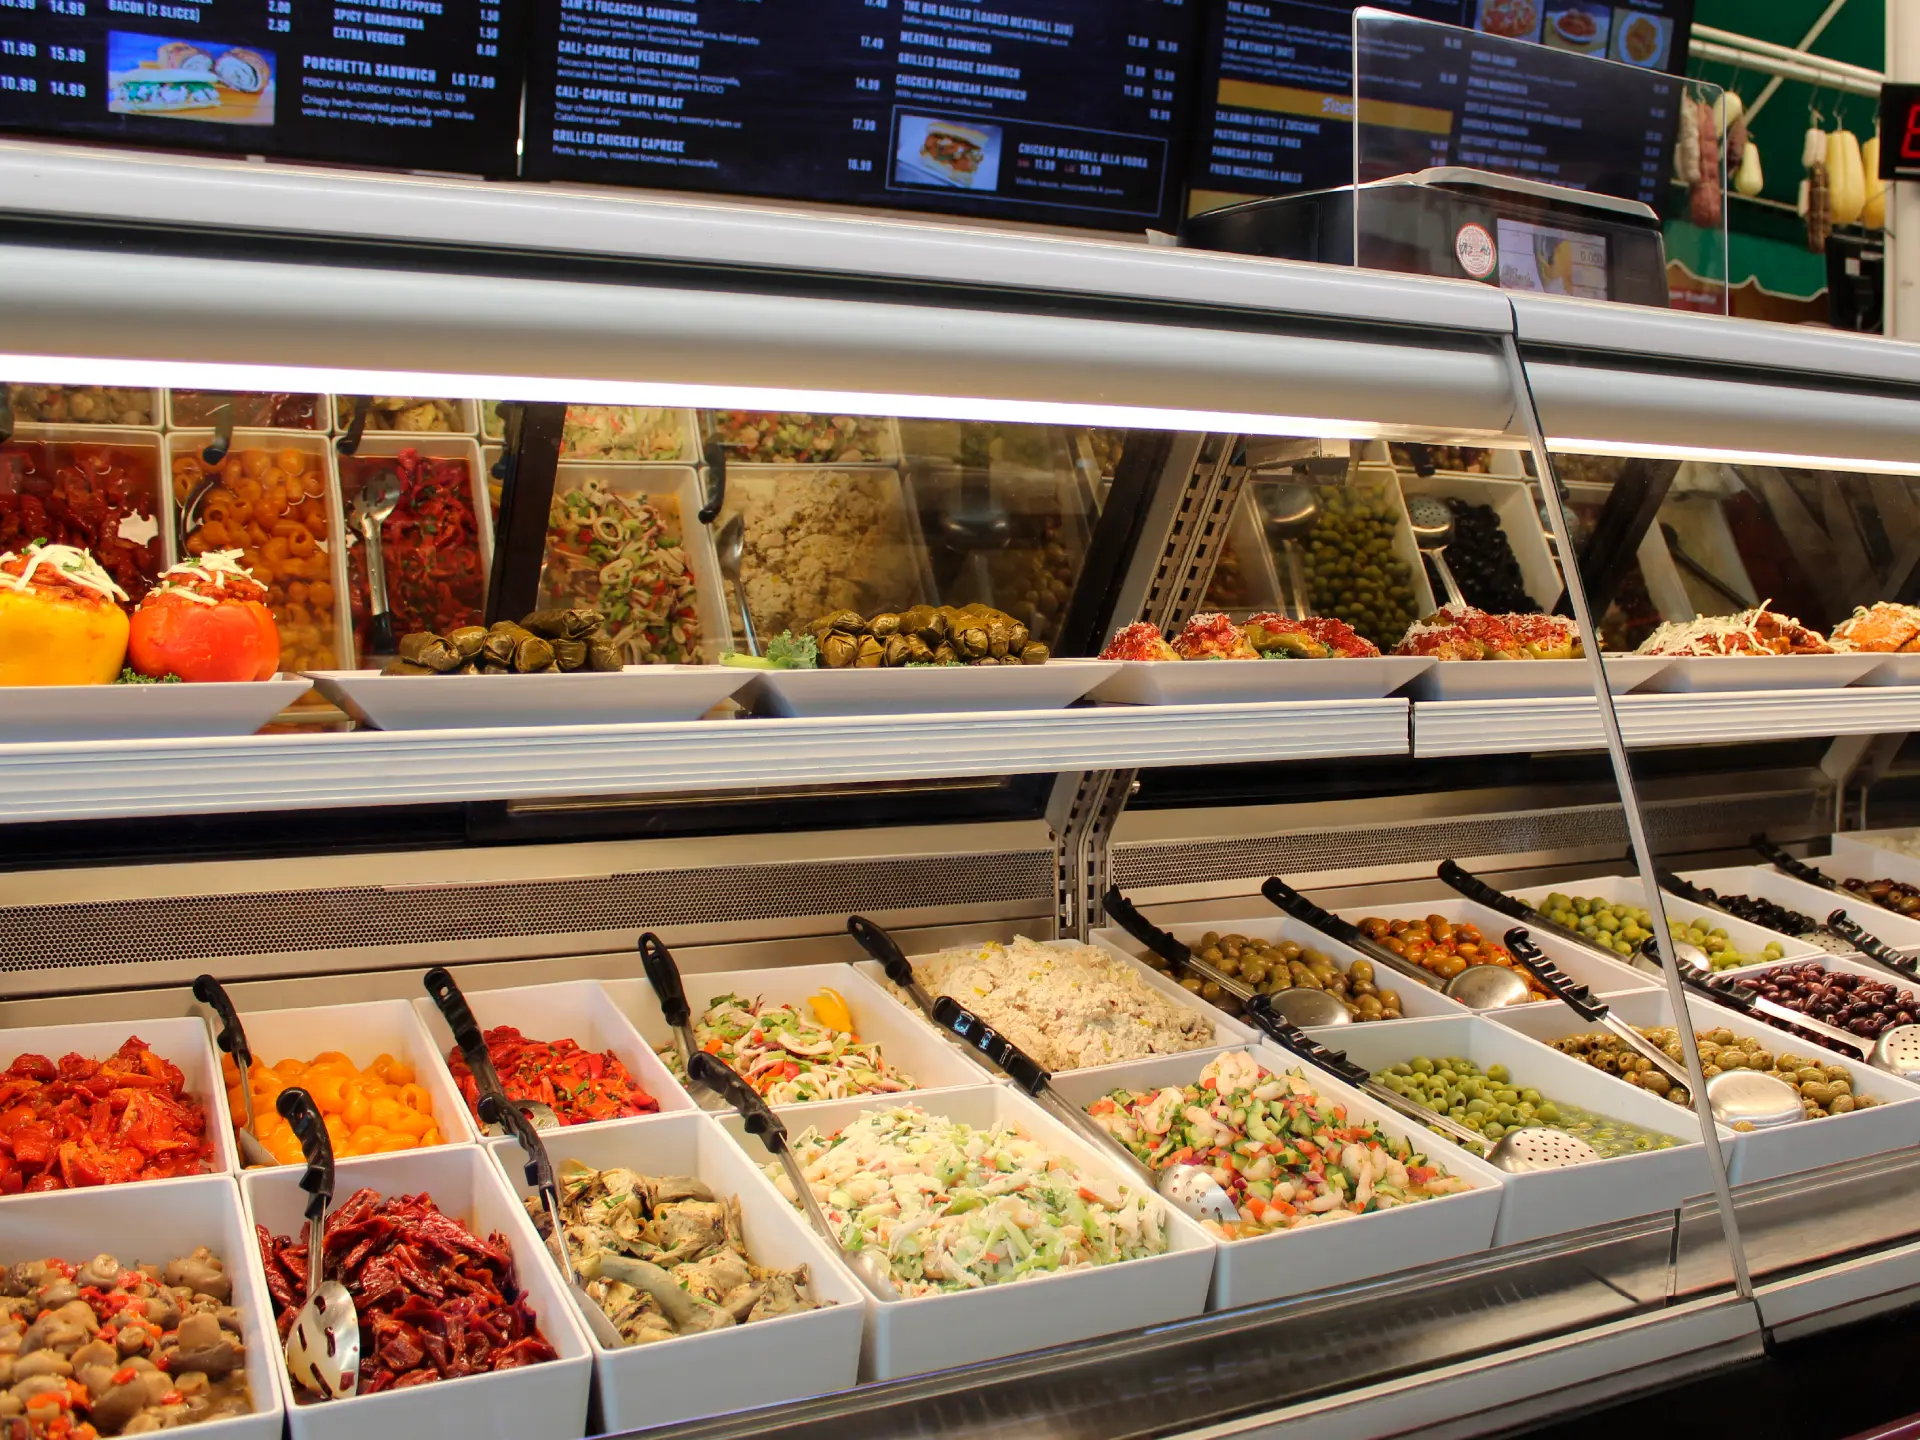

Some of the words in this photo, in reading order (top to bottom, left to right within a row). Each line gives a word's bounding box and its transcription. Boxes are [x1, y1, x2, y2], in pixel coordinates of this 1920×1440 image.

[107, 0, 145, 14] BACON
[145, 2, 159, 17] (2
[160, 6, 200, 23] SLICES)
[334, 8, 361, 23] SPICY
[400, 0, 443, 15] PEPPERS
[480, 9, 499, 22] 1.50
[595, 0, 644, 18] FOCACCIA
[646, 6, 698, 25] SANDWICH
[904, 0, 921, 14] THE
[268, 18, 291, 32] 2.50
[479, 26, 499, 39] 1.50
[333, 26, 363, 41] EXTRA
[365, 30, 406, 46] VEGGIES
[900, 31, 945, 48] MEATBALL
[946, 37, 993, 54] SANDWICH
[1, 39, 36, 57] 11.99
[49, 44, 86, 63] 15.99
[558, 39, 631, 60] CALI-CAPRESE
[303, 54, 372, 76] PORCHETTA
[374, 62, 437, 83] SANDWICH
[452, 72, 467, 87] LG
[467, 74, 497, 89] 17.99
[897, 51, 935, 68] GRILLED
[975, 62, 1022, 80] SANDWICH
[49, 80, 86, 98] 14.99
[302, 76, 337, 89] FRIDAY
[346, 81, 393, 96] SATURDAY
[895, 73, 935, 89] CHICKEN
[935, 78, 982, 95] PARMESAN
[982, 85, 1028, 102] SANDWICH
[301, 93, 331, 108] Crispy
[555, 84, 628, 104] CALI-CAPRESE
[629, 92, 656, 107] WITH
[657, 95, 685, 110] MEAT
[552, 128, 596, 145] GRILLED
[596, 132, 641, 149] CHICKEN
[641, 137, 686, 154] CAPRESE
[1018, 142, 1056, 157] CHICKEN
[1056, 147, 1099, 163] MEATBALL
